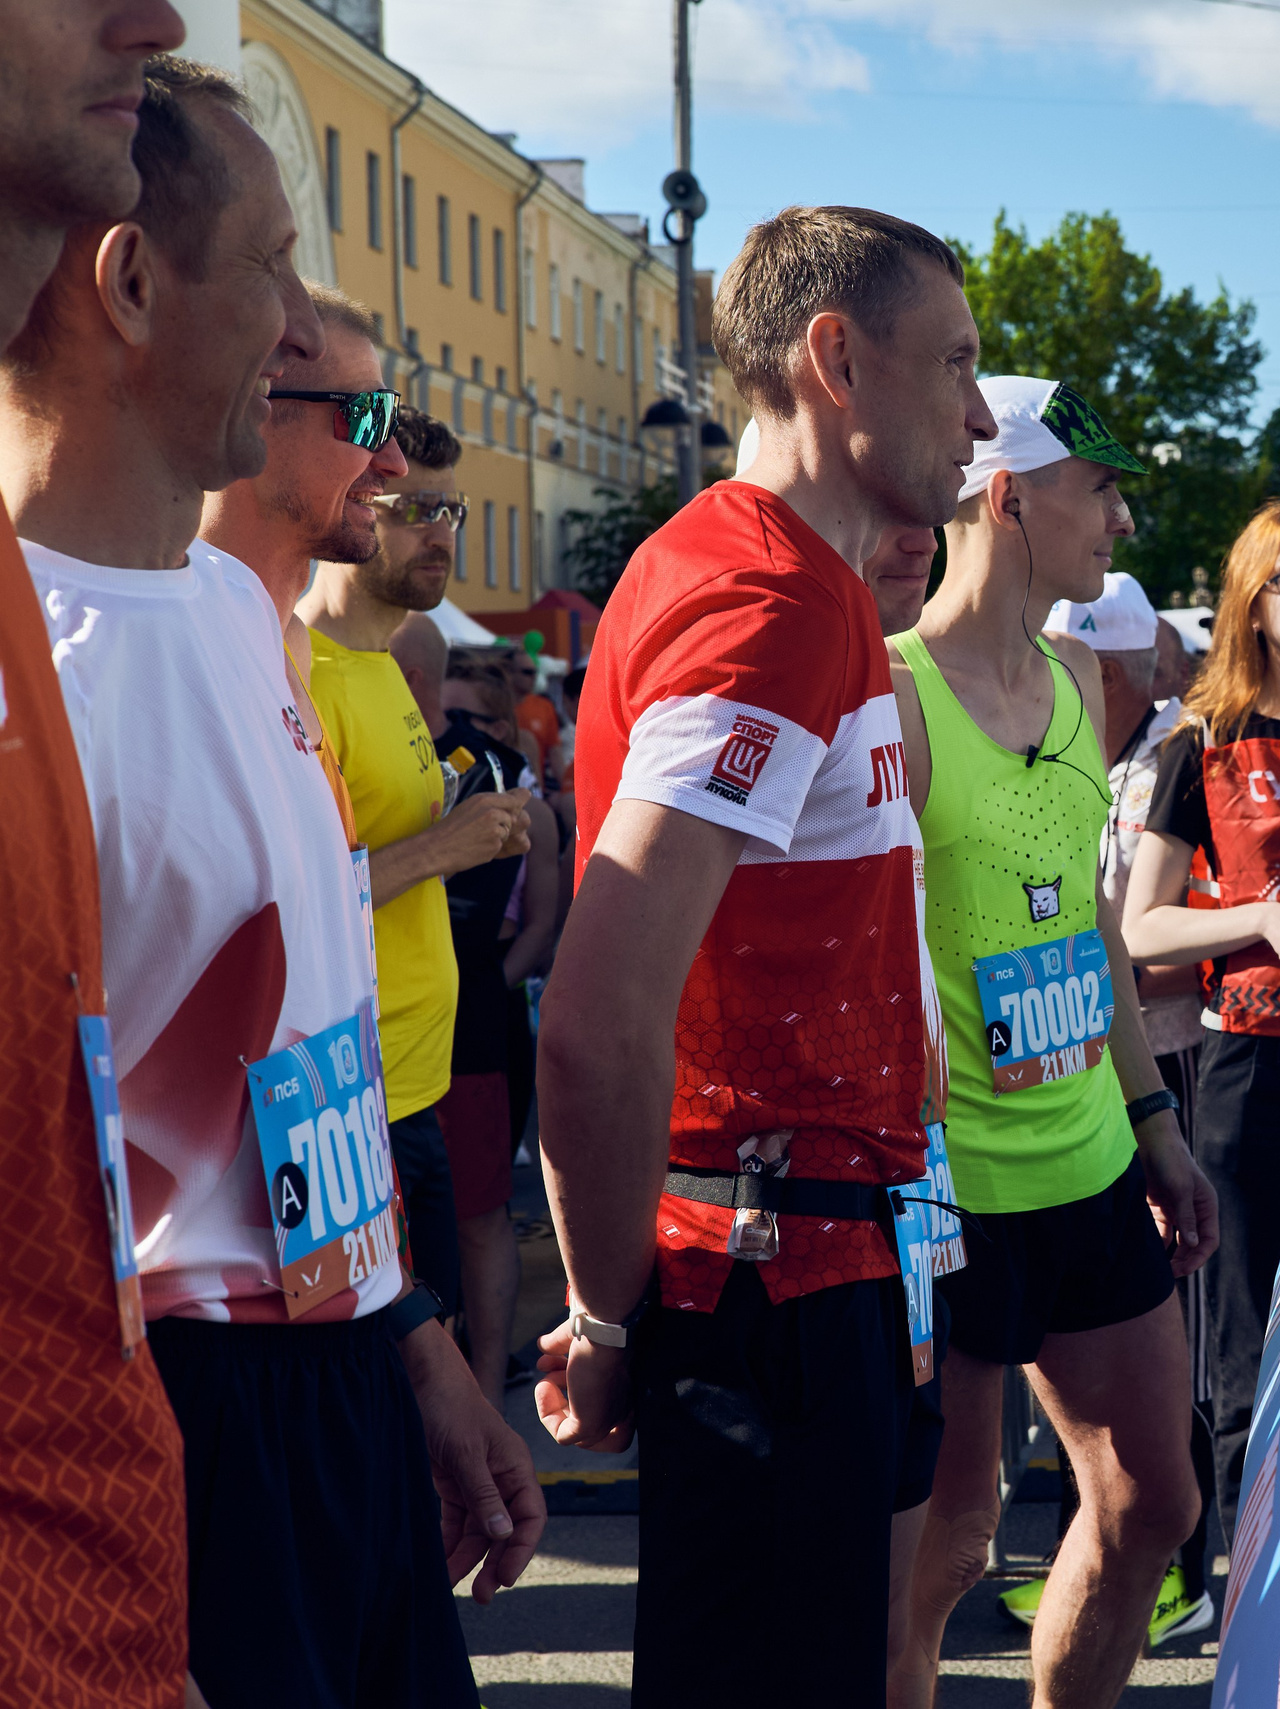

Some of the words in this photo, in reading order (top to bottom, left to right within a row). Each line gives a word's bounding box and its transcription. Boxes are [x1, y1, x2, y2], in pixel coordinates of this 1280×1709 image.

[732, 721, 778, 746] СПОРТ
[705, 781, 748, 807] ЛУКОЙЛ
[996, 968, 1015, 982] ПСБ
[999, 970, 1105, 1059] 70002
[274, 1076, 300, 1103] ПСБ
